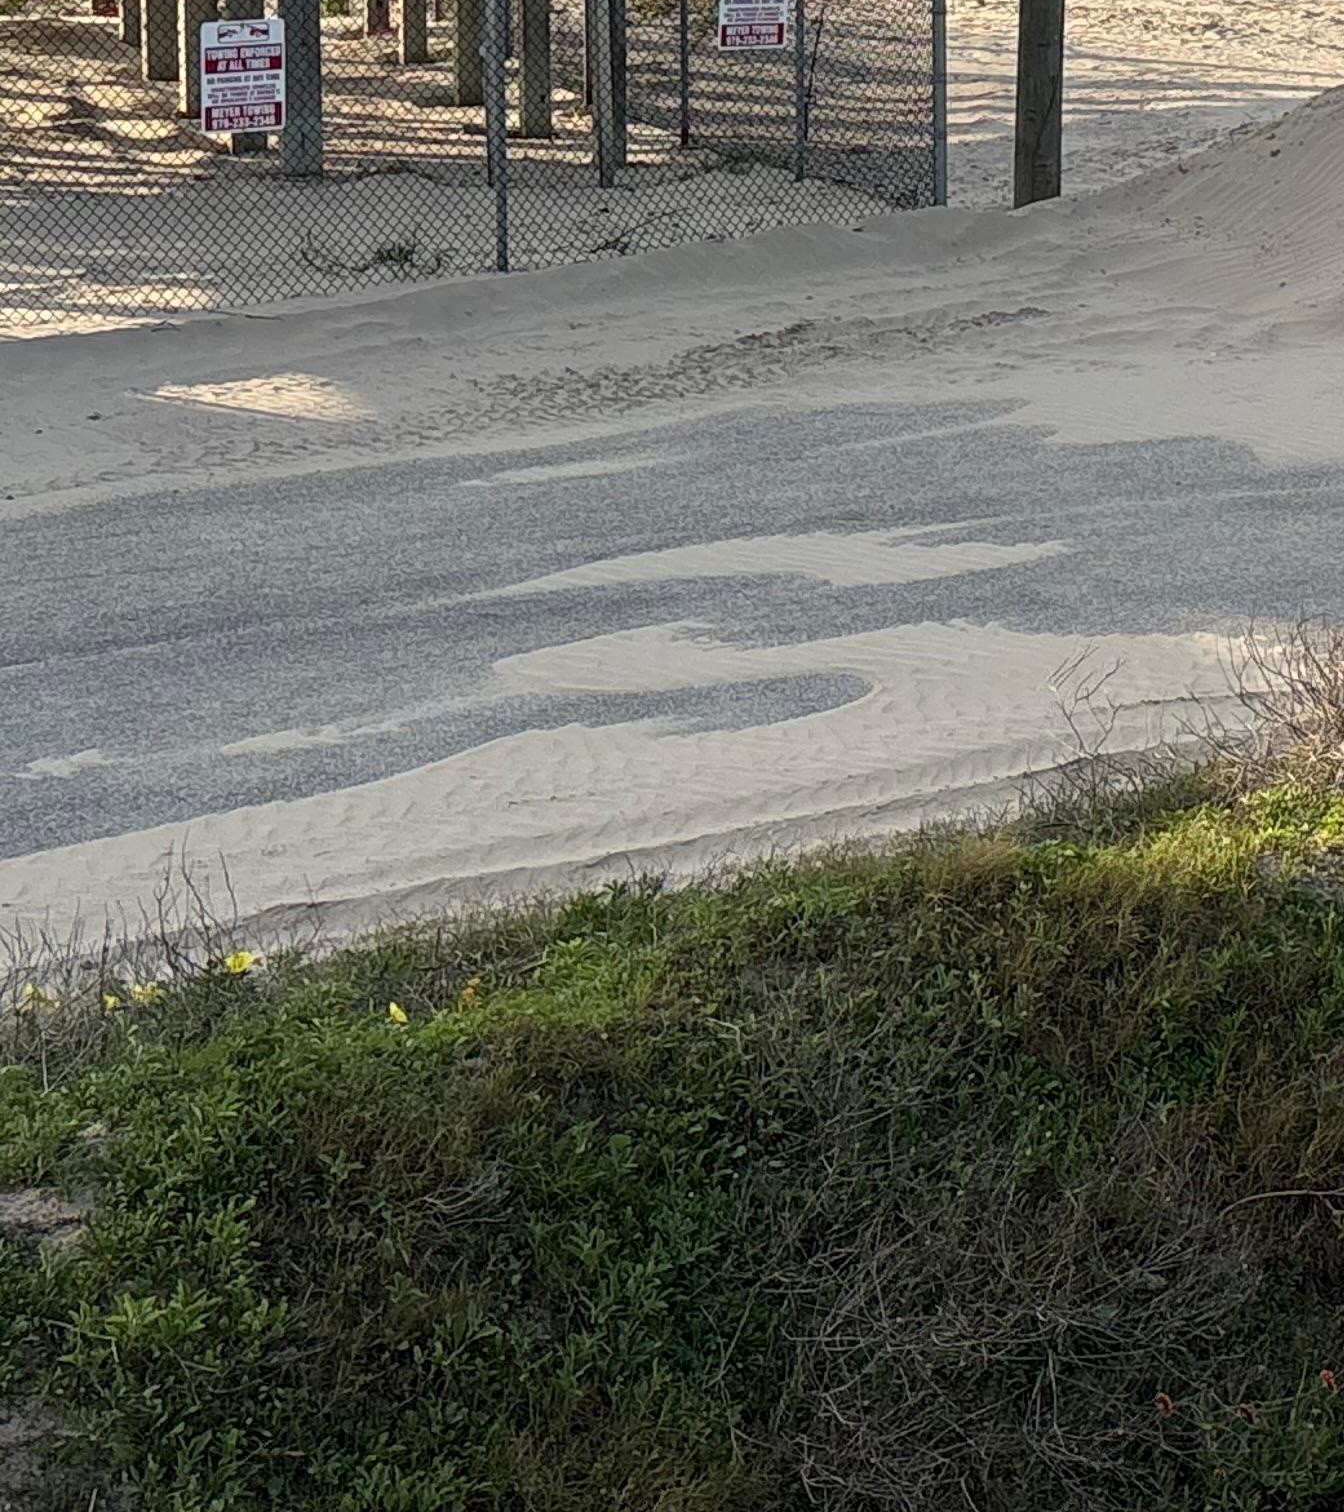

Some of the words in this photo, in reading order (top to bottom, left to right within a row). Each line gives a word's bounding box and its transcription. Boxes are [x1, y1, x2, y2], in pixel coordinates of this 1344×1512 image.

[206, 48, 238, 61] TOWING
[240, 46, 281, 59] ENFORCED
[217, 59, 228, 71] AT
[228, 59, 244, 71] ALL
[245, 58, 271, 70] TIMES
[242, 103, 276, 117] TOWING
